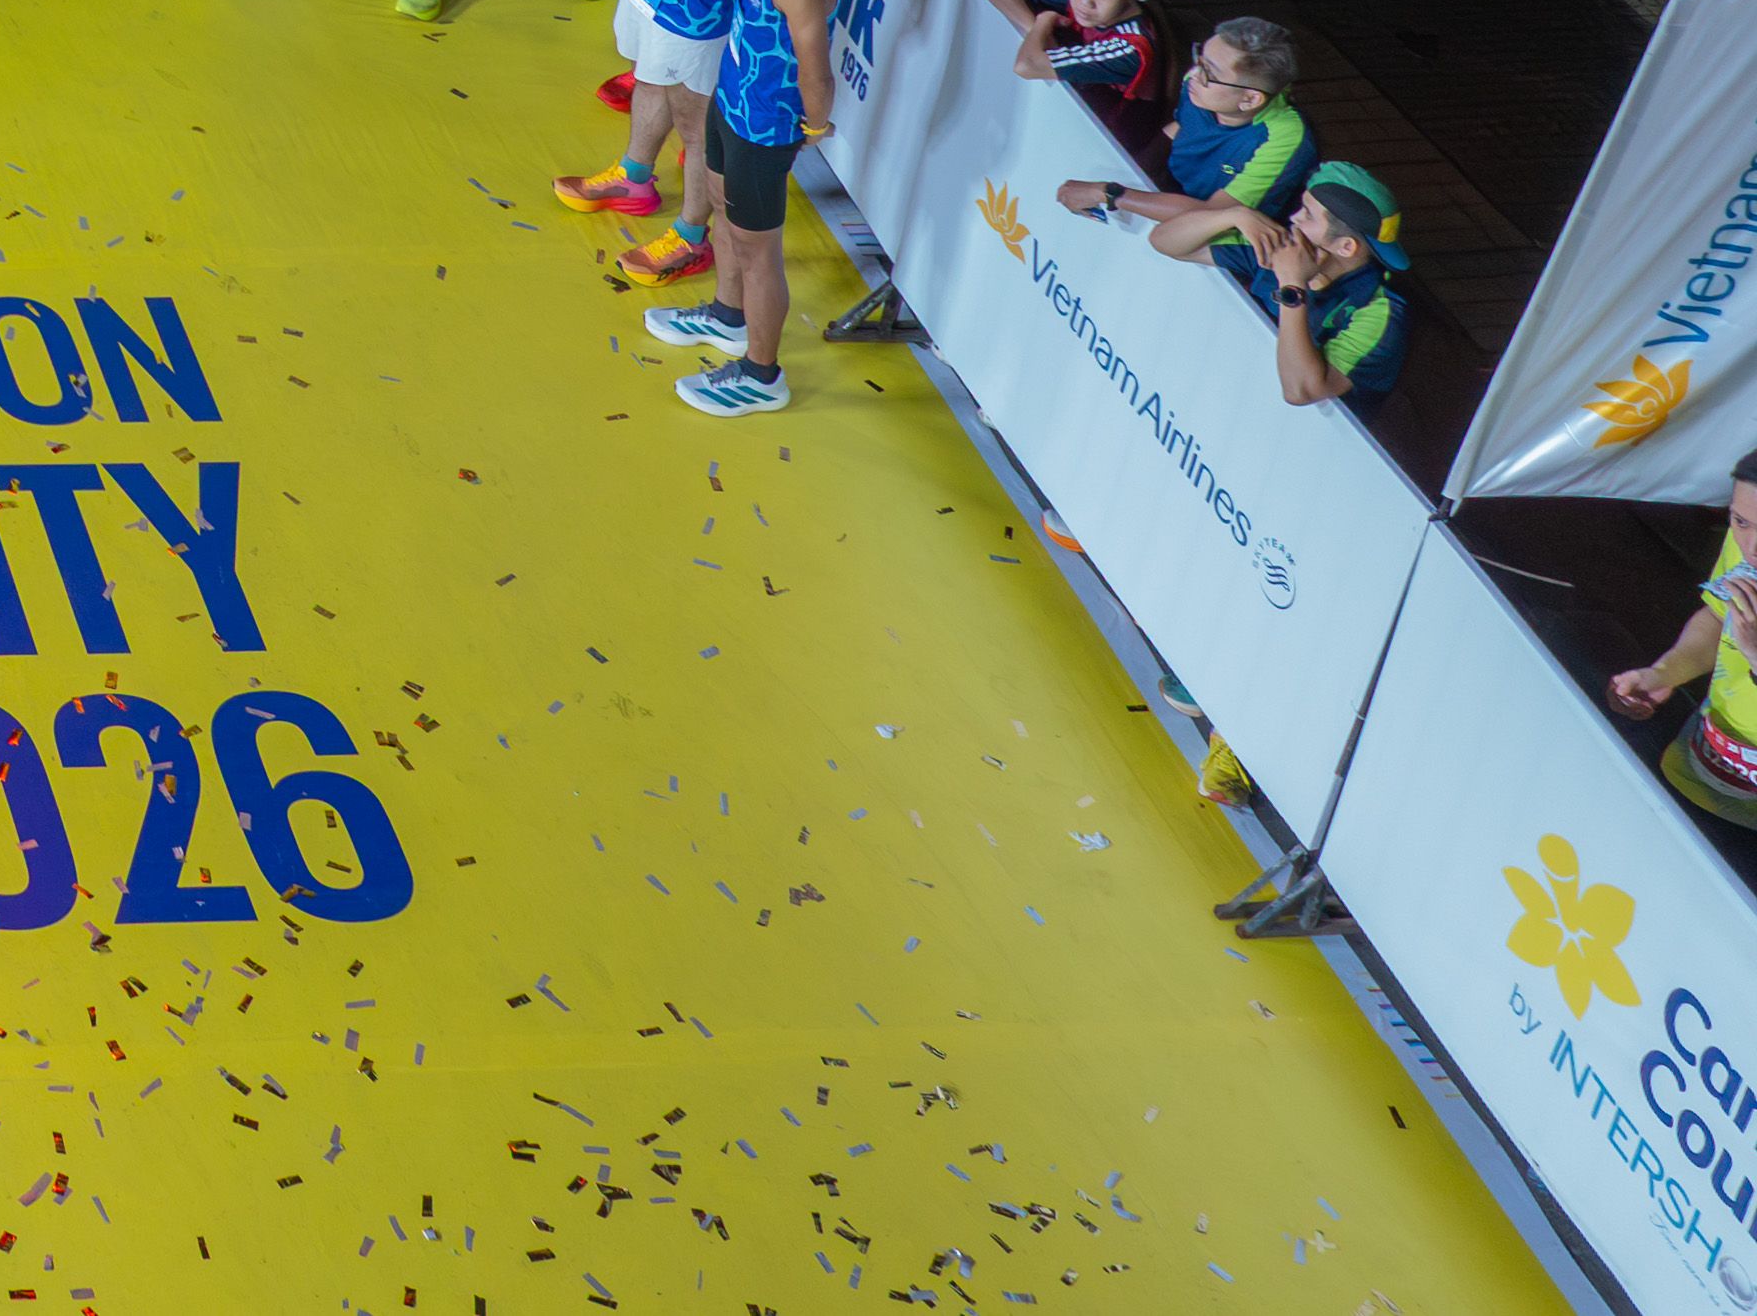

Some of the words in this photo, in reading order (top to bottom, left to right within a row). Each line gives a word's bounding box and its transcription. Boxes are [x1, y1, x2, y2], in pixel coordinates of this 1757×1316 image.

[839, 45, 869, 103] 1976
[1030, 237, 1137, 405] Vietnam
[1137, 393, 1252, 548] Airlines
[1509, 981, 1542, 1035] by
